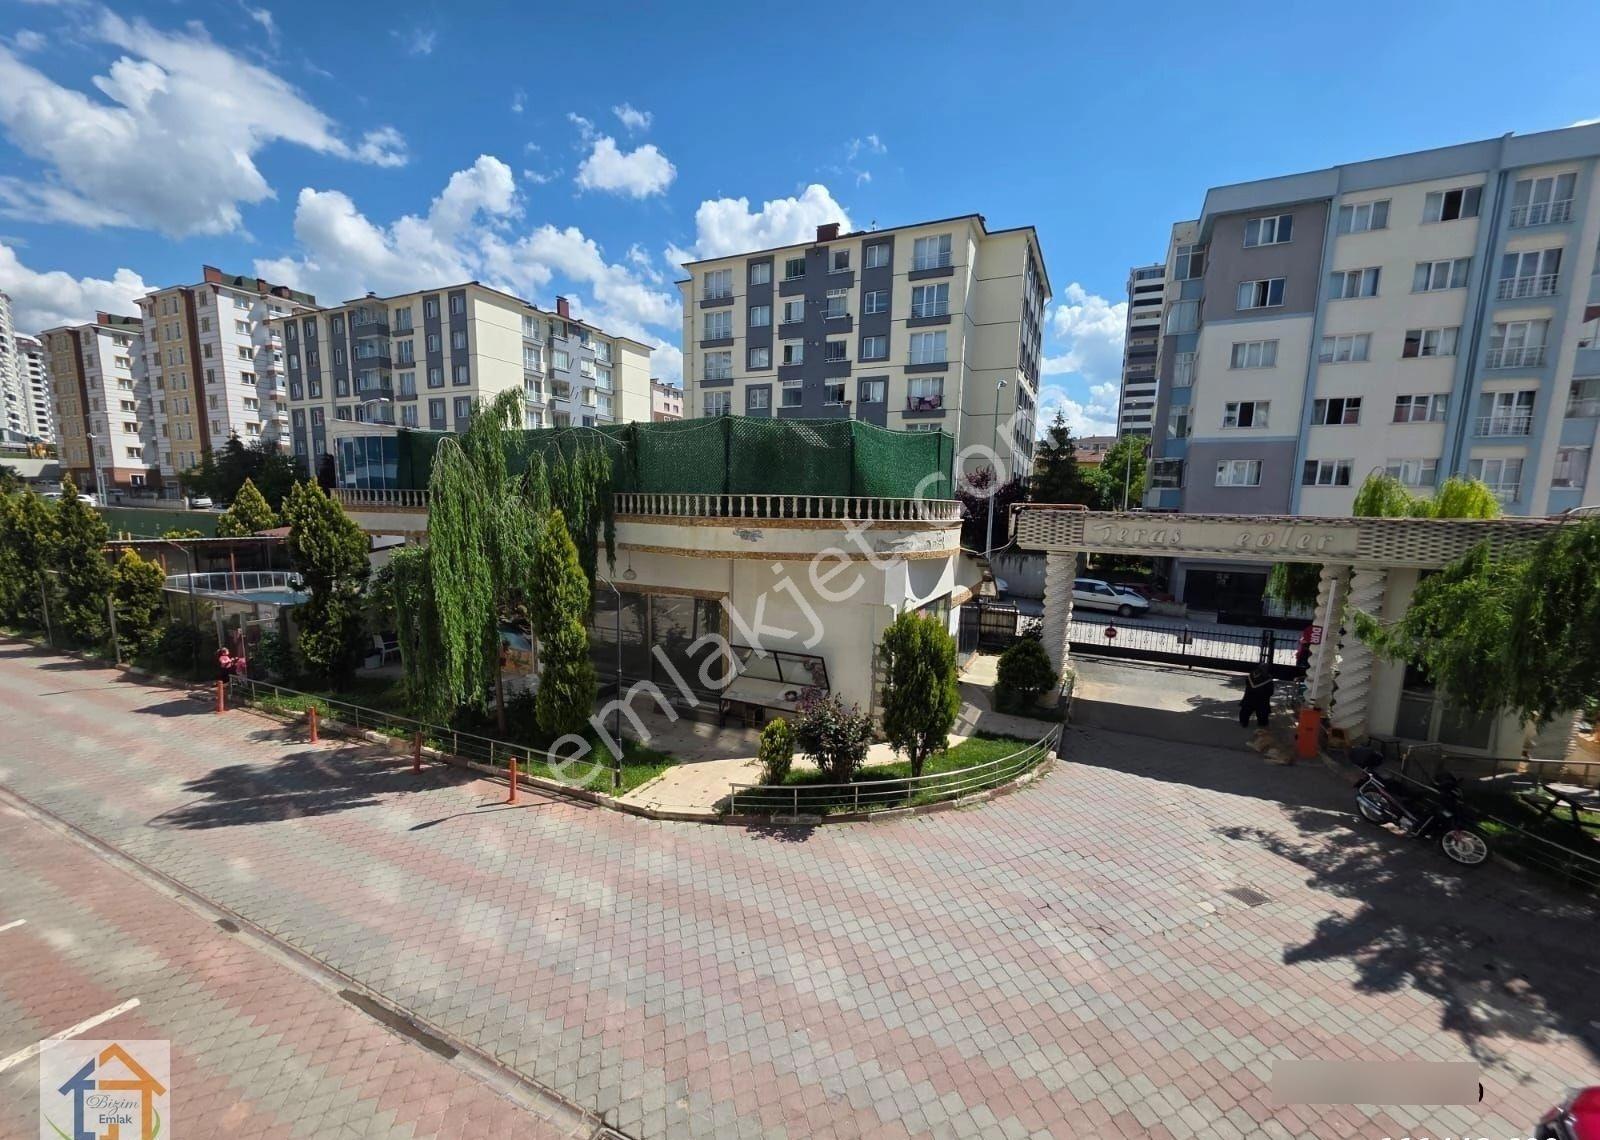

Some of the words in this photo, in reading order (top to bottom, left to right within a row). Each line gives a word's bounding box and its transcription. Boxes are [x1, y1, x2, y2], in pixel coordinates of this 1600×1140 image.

[1093, 522, 1183, 546] Teras
[1235, 526, 1336, 550] evler
[1311, 627, 1322, 644] DUR
